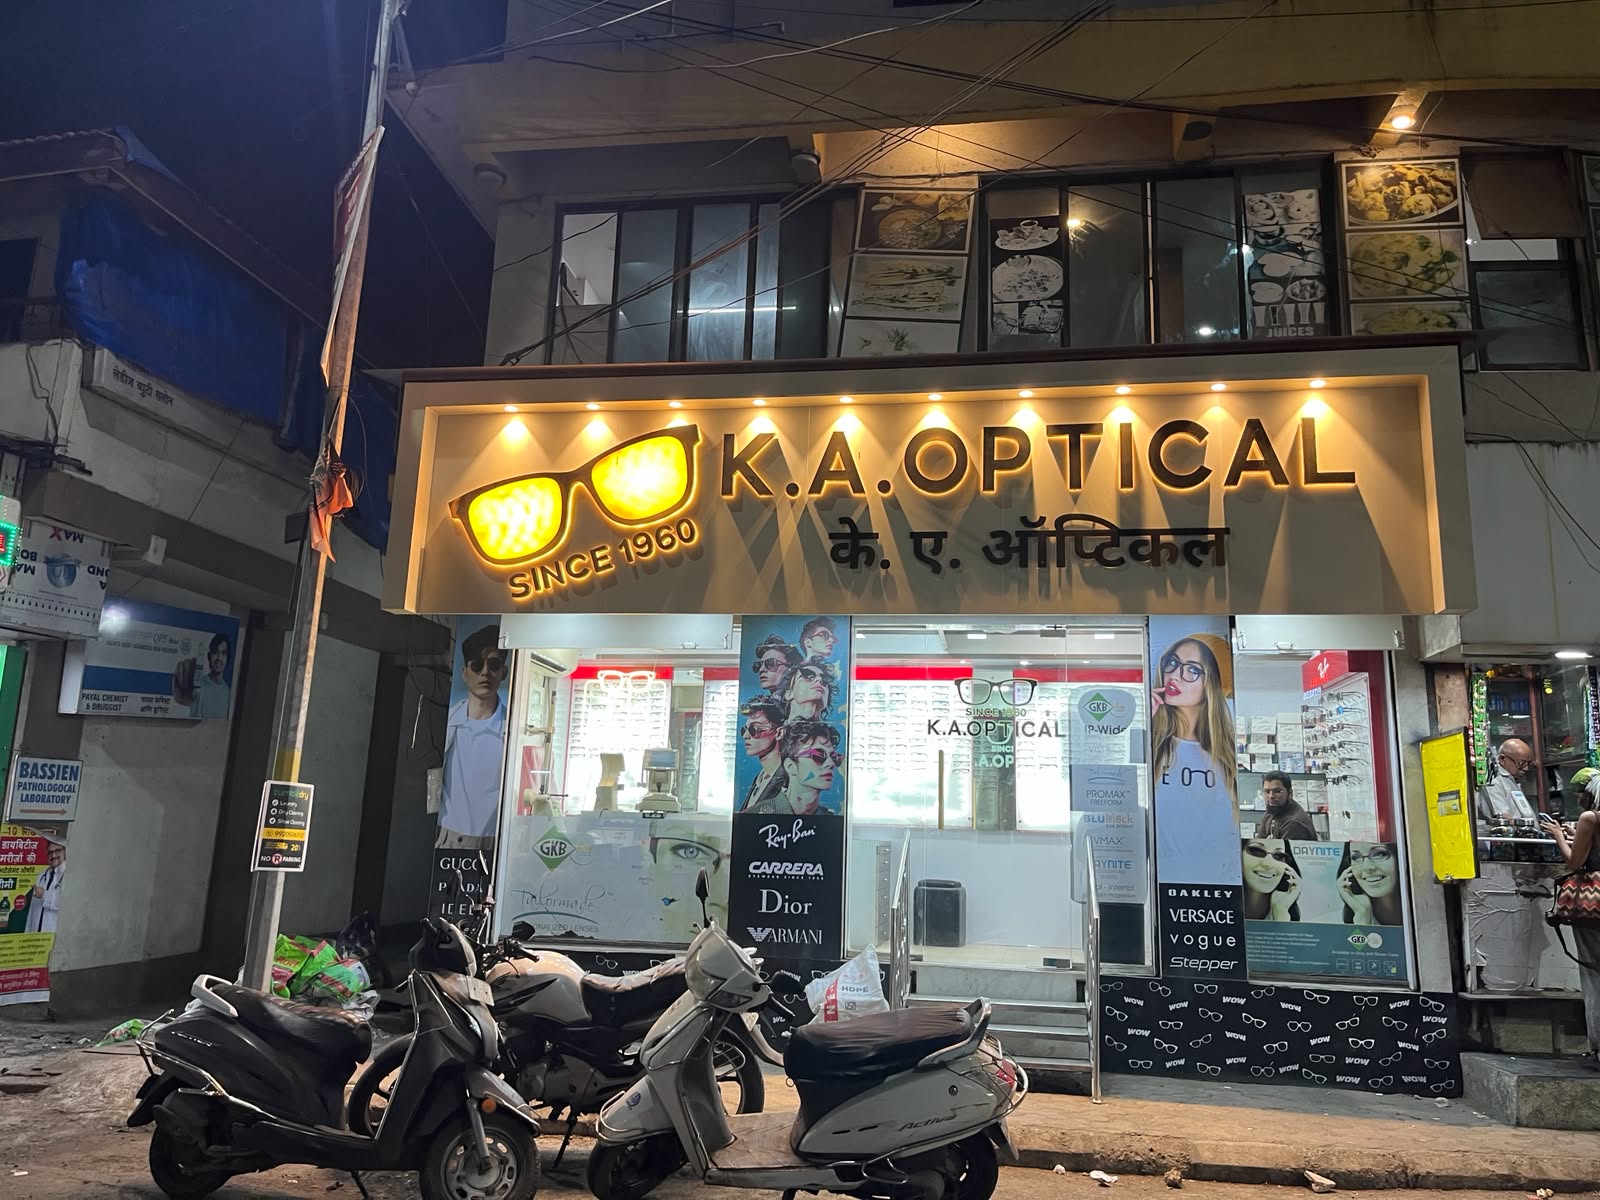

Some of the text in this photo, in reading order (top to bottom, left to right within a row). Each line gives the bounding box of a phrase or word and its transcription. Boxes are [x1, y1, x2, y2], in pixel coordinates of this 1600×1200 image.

[1265, 325, 1315, 338] JUICES
[721, 417, 1356, 498] K.A.OPTICAL
[49, 526, 84, 544] MAX
[828, 513, 1231, 574] के. ए. ऑप्टिकल
[20, 549, 38, 562] BO
[509, 518, 697, 598] SINCE 1960
[81, 693, 129, 703] PAYAL CHEMIST
[92, 702, 123, 712] DRUGGIST
[965, 707, 999, 717] SINCE
[1088, 701, 1109, 713] GKB
[927, 719, 1067, 738] K.A.OPTICAL
[19, 761, 80, 783] BASSIEN
[20, 793, 72, 805] LABORATORY
[1086, 789, 1126, 799] PROMAX
[1093, 836, 1123, 845] VMAX
[540, 841, 568, 857] GKB
[1293, 846, 1341, 857] DAYNITE
[748, 861, 824, 876] CARRERA
[1168, 888, 1234, 898] OAKLEY
[758, 889, 813, 915] Dior
[1169, 907, 1235, 925] VERSACE
[570, 924, 600, 933] LENSES
[767, 927, 823, 945] ARMANI
[1169, 933, 1237, 950] vogue
[1169, 956, 1239, 972] Stepper
[841, 985, 869, 993] HDPE
[1124, 996, 1144, 1006] WOW
[1168, 1001, 1188, 1011] WOW
[1222, 996, 1246, 1005] WOW
[1389, 999, 1410, 1010] WOW
[1280, 1001, 1302, 1012] WOW
[1422, 1015, 1447, 1024] WOW
[1127, 1028, 1151, 1037] WOW
[1225, 1030, 1246, 1041] WOW
[1309, 1035, 1330, 1046] WOW
[1397, 1040, 1420, 1052] WOW
[1165, 1058, 1185, 1068] WOW
[1225, 1056, 1247, 1064] WOW
[1345, 1056, 1370, 1066] WOW
[1278, 1063, 1300, 1073] WOW
[1335, 1075, 1361, 1084] WOW
[1401, 1075, 1426, 1083] WOW
